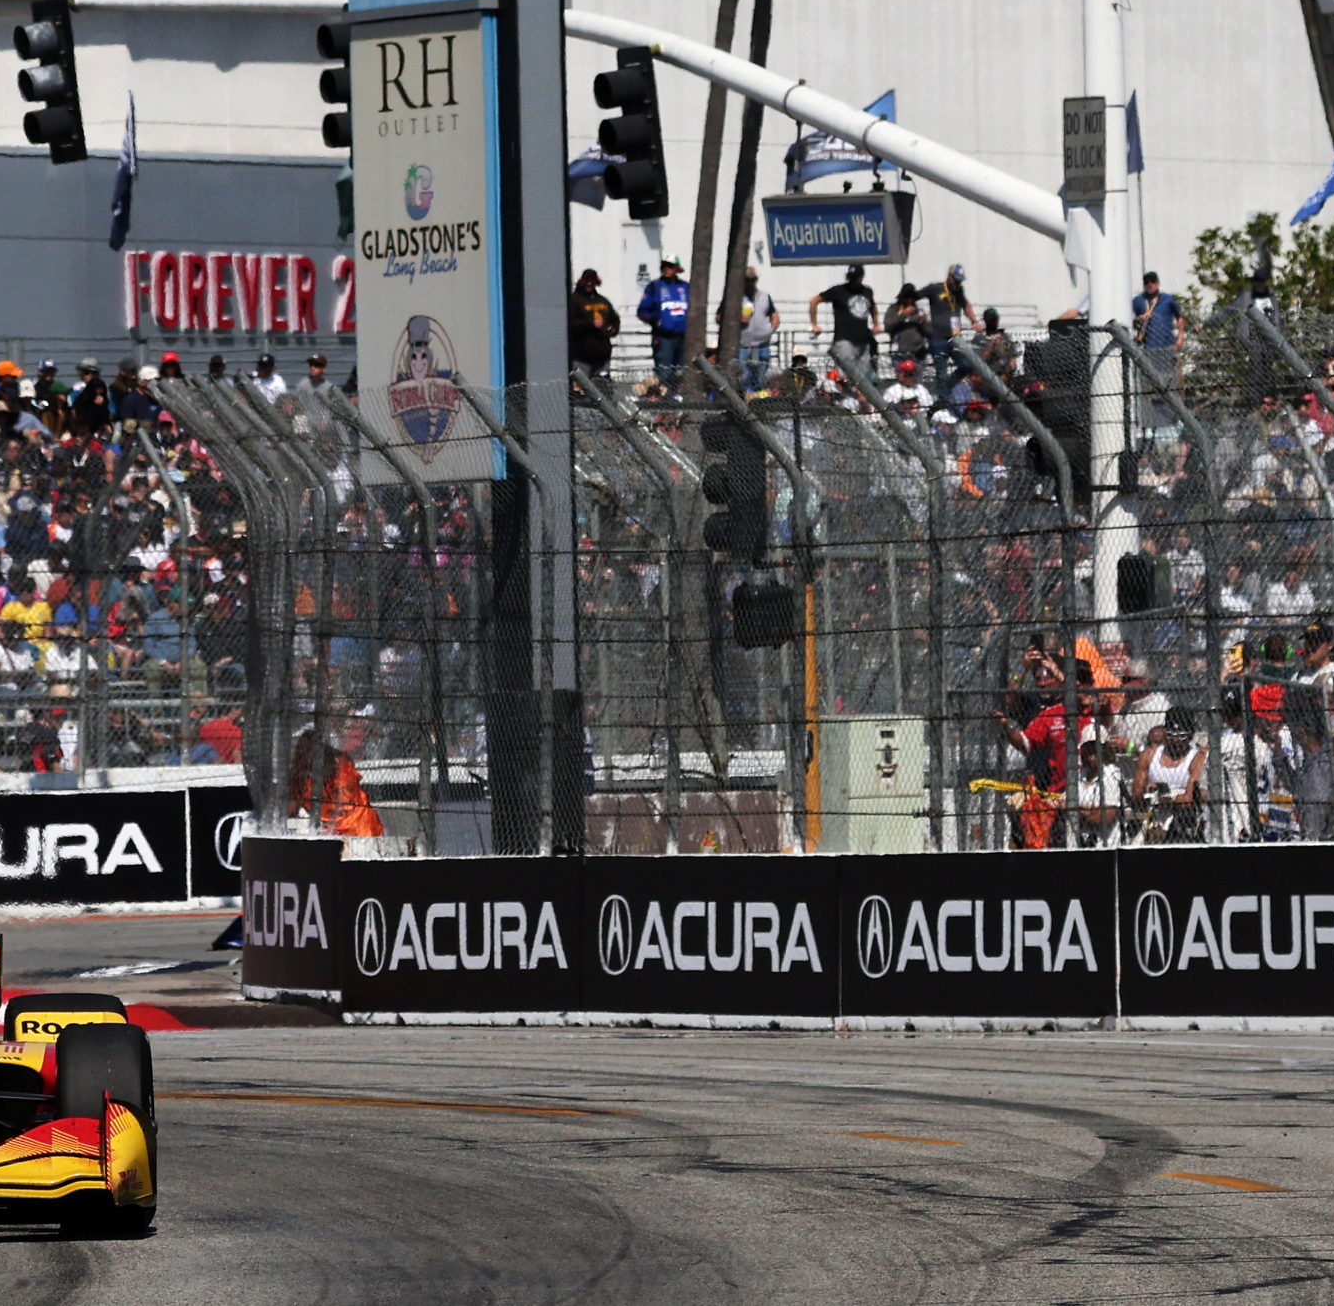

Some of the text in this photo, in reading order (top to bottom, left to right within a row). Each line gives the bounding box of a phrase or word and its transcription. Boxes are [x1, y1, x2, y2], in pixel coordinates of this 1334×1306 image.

[377, 35, 459, 114] RH
[378, 113, 459, 139] OUTLET
[1065, 110, 1104, 135] DO NOT
[1064, 144, 1104, 169] BLOCK
[361, 220, 481, 260] GLADSTONE'S
[772, 215, 884, 253] Aquarium Way
[125, 250, 318, 333] FOREVER
[383, 249, 458, 283] Long Beach
[245, 880, 328, 950] ACURA
[389, 901, 567, 971] ACURA
[634, 900, 822, 973] ACURA
[896, 898, 1098, 973] ACURA
